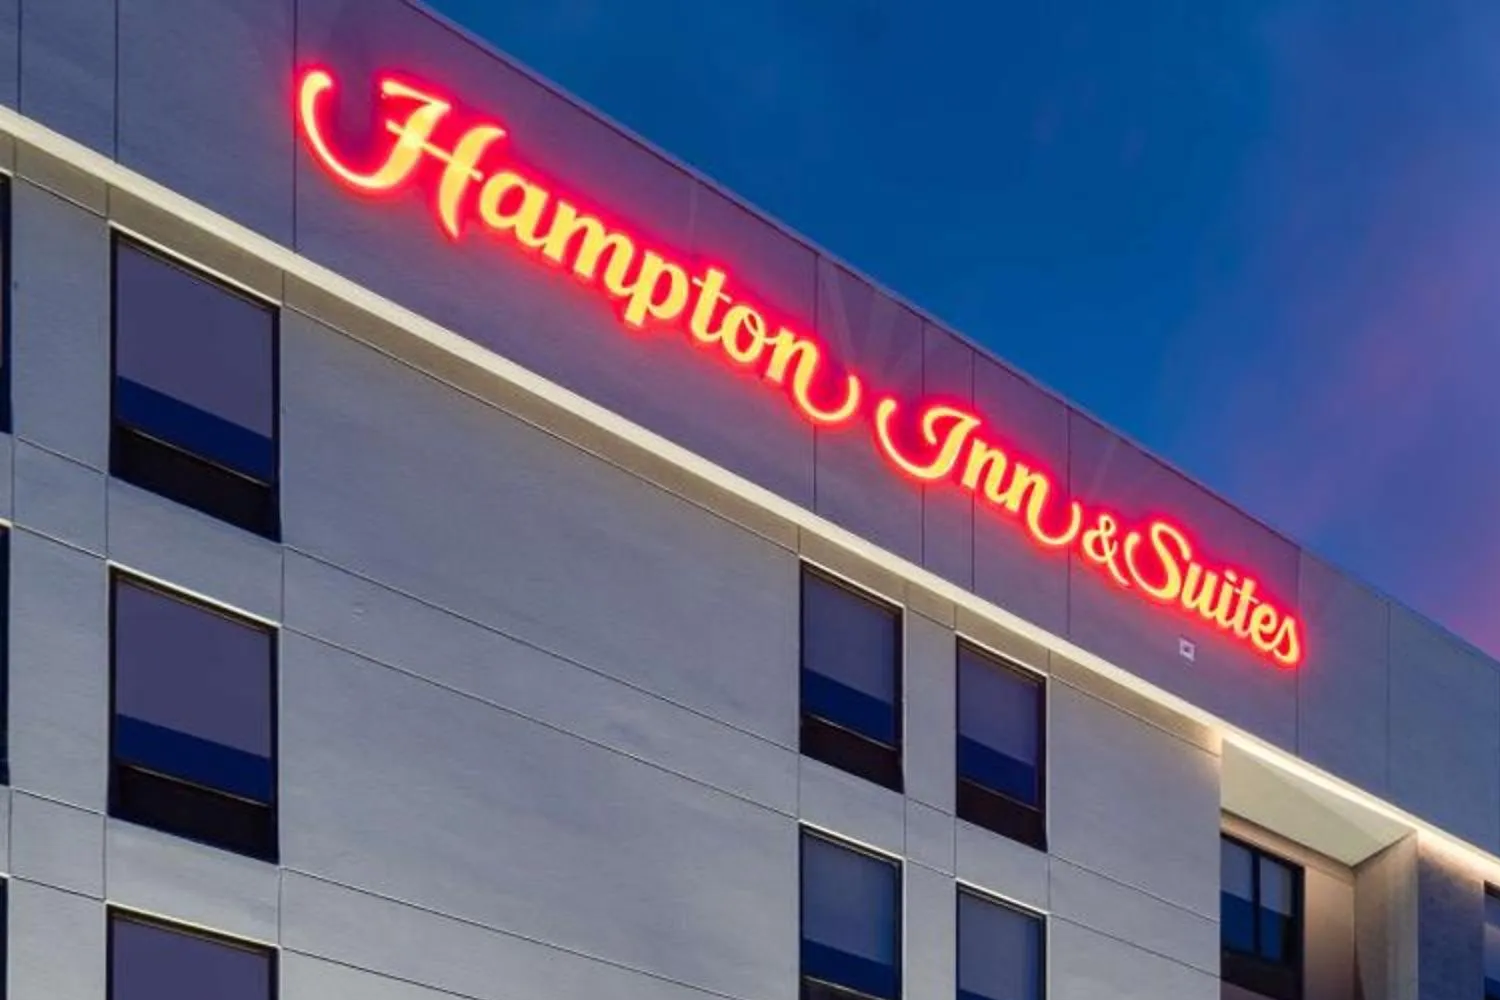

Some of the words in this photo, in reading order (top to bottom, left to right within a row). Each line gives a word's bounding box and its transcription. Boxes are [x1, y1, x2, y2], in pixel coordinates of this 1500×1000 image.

[300, 71, 860, 422] Hampton
[876, 399, 1081, 546] Inn
[1082, 514, 1130, 586] &
[1124, 522, 1299, 664] Suites
